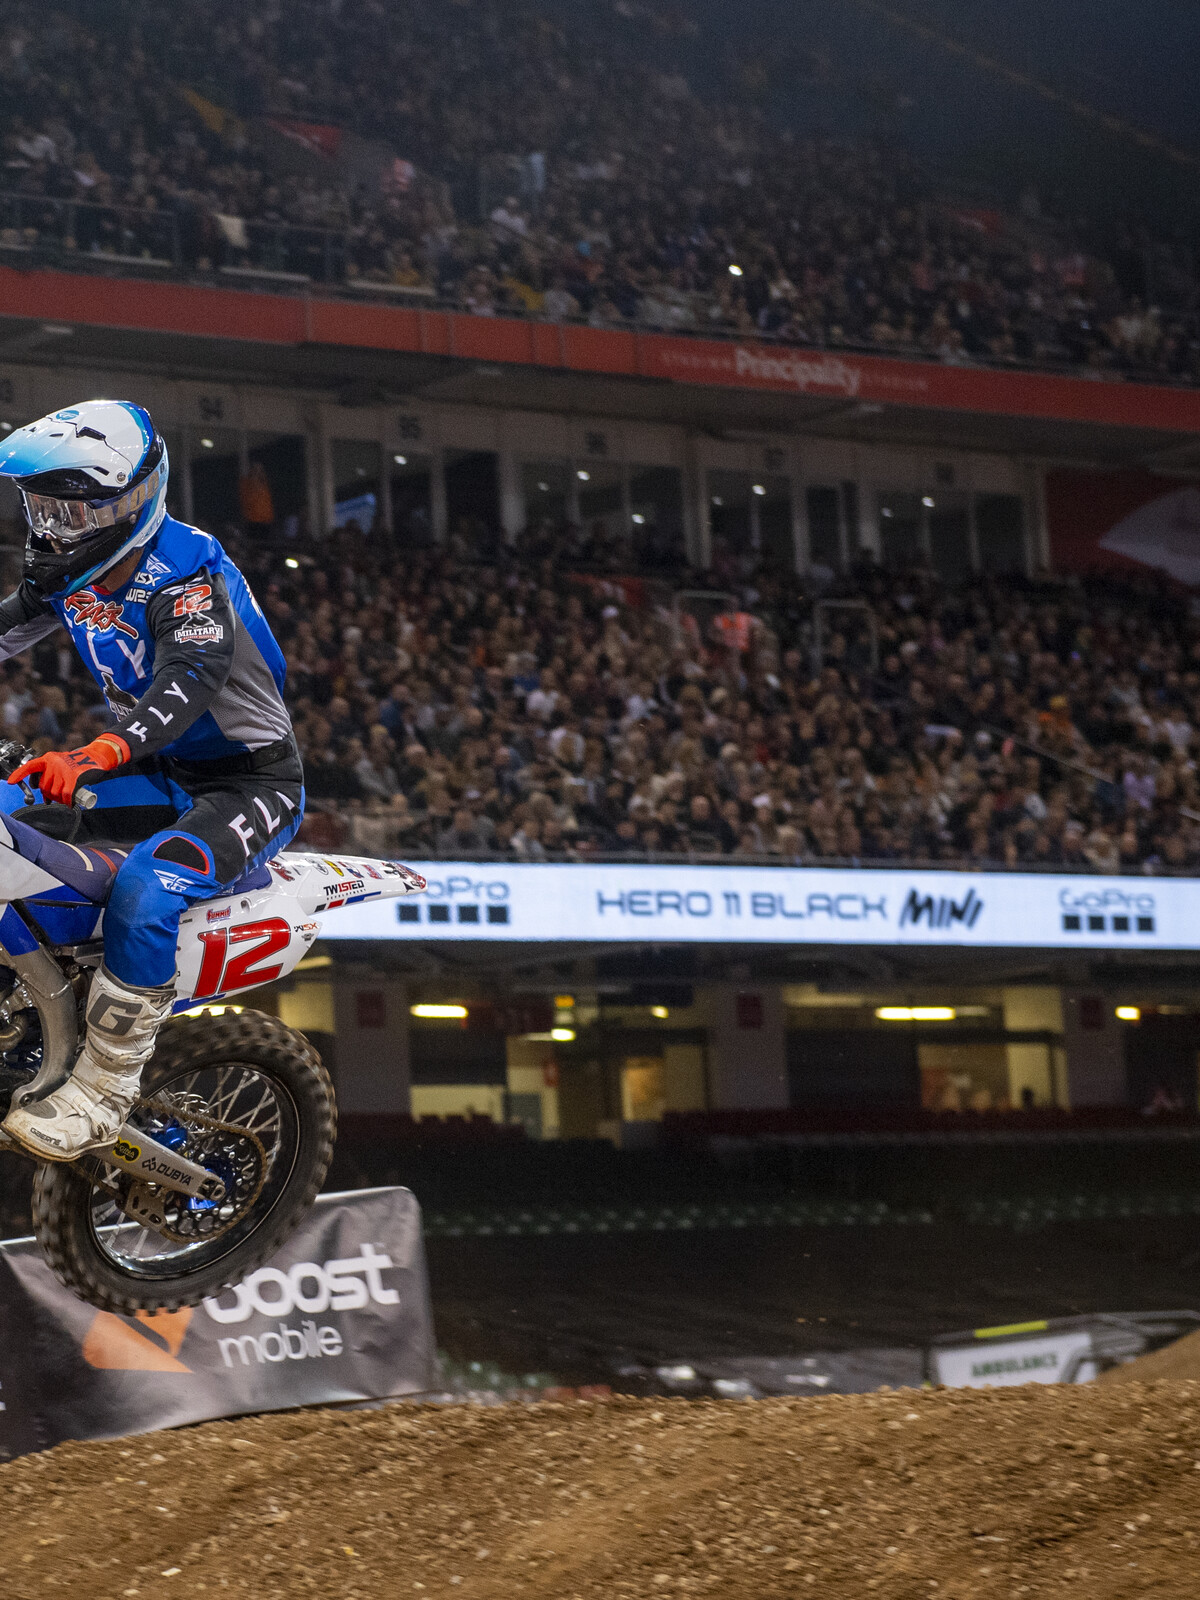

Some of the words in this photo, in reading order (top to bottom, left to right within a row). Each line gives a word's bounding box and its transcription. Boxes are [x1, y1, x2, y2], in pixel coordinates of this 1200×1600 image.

[736, 349, 860, 396] Principality
[174, 585, 212, 617] 12
[63, 612, 147, 680] LY
[176, 626, 221, 639] MILITARY
[126, 681, 189, 743] FLY
[424, 876, 511, 900] oPro
[596, 889, 712, 918] HERO
[721, 890, 742, 918] 11
[751, 891, 888, 921] BLACK
[899, 885, 984, 929] MINI
[1058, 887, 1157, 913] GoPro
[191, 916, 292, 1000] 12
[88, 993, 144, 1036] G
[156, 1163, 192, 1186] DUBYA
[217, 1320, 344, 1368] mobile
[970, 1353, 1058, 1377] AMBULANCE
